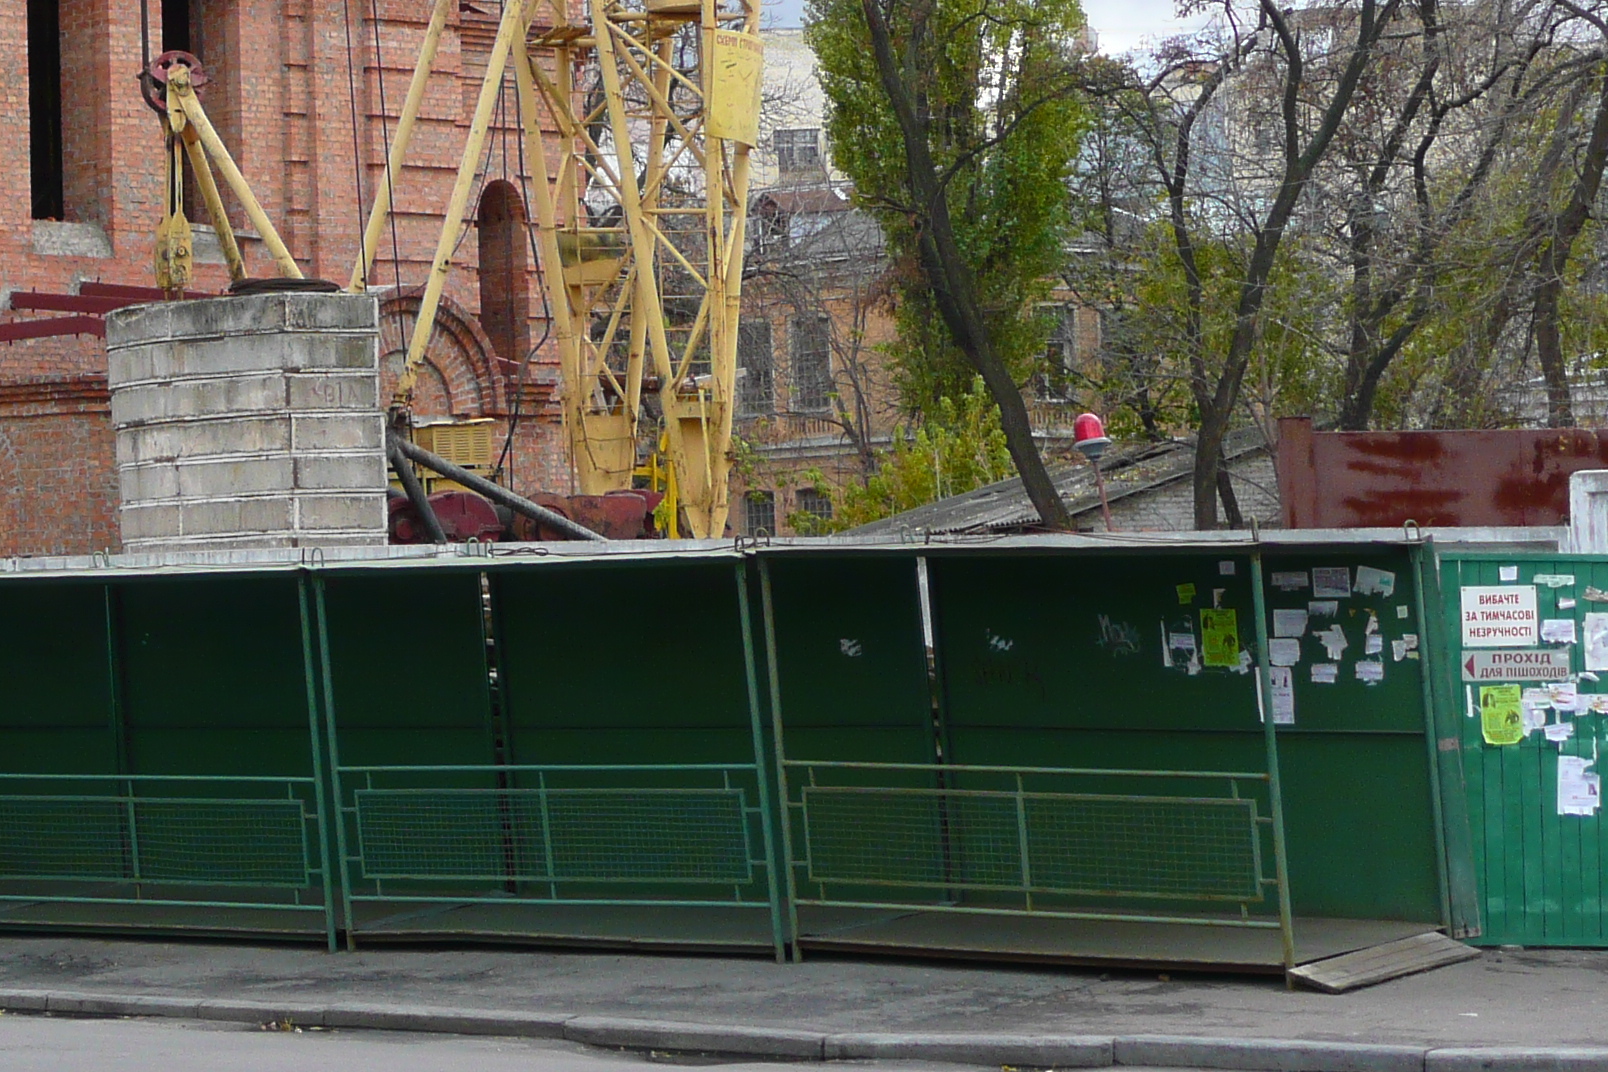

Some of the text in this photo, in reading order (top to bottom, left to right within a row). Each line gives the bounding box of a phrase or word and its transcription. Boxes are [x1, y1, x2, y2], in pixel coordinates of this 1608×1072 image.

[1479, 594, 1520, 605] ВИБАЧТЕ
[1465, 610, 1534, 621] ЗА ТИМЧАСОВІ
[1469, 626, 1532, 638] НЕЗРУЧНОСТІ
[1492, 653, 1551, 665] ПРОХІД
[1480, 667, 1568, 678] ДЛЯ ПІШОХОДІВ
